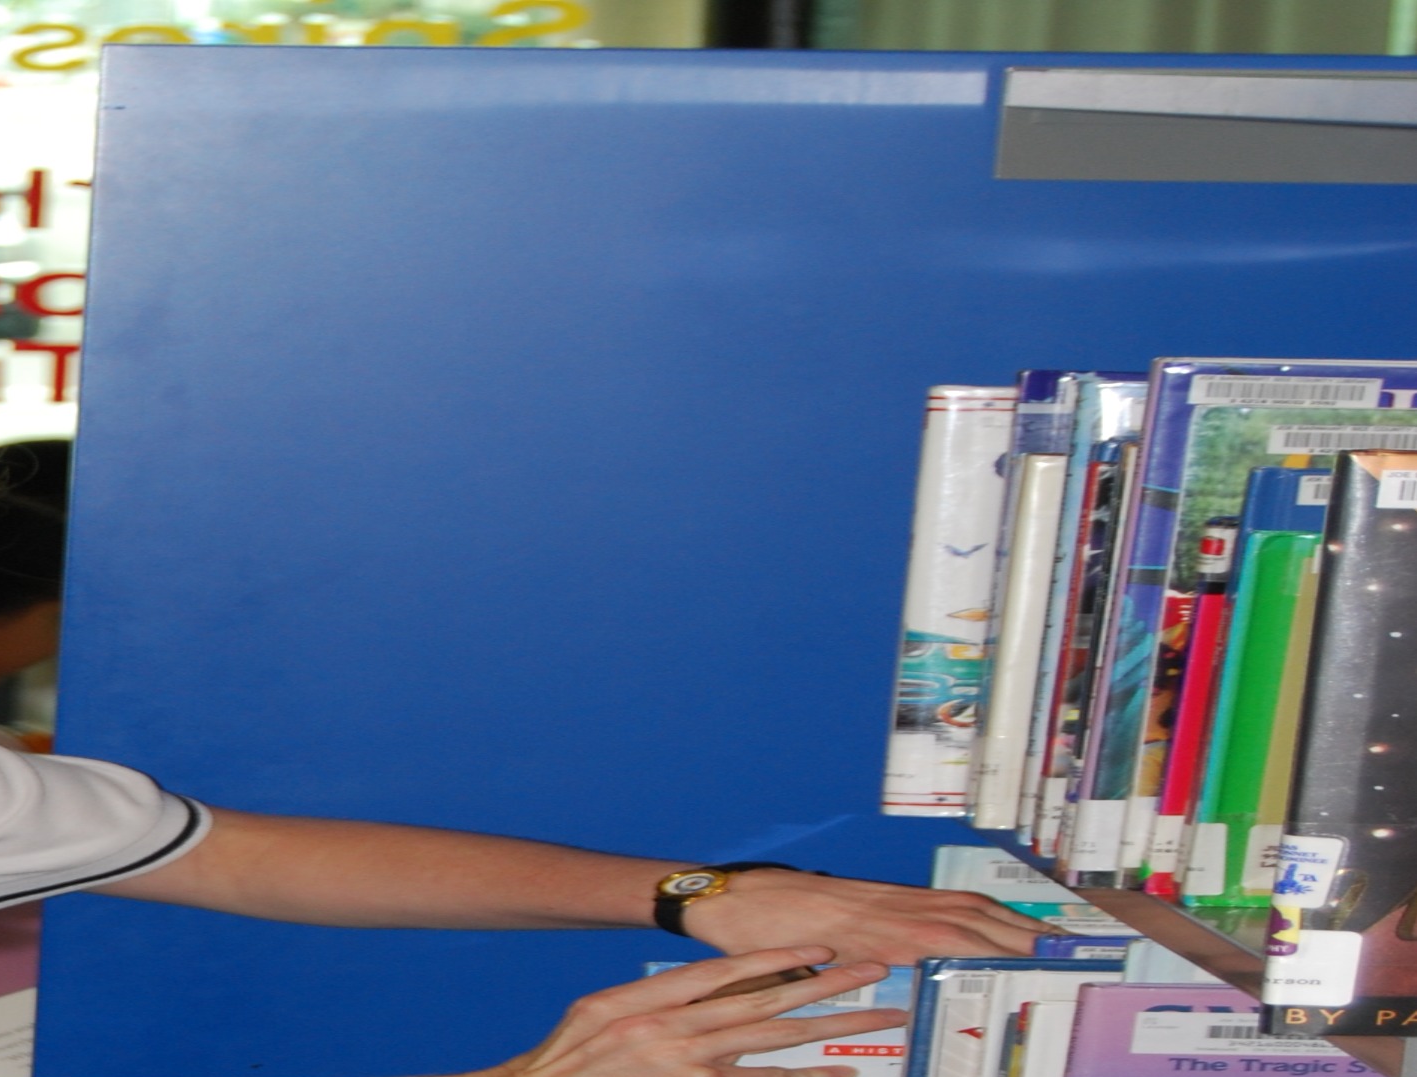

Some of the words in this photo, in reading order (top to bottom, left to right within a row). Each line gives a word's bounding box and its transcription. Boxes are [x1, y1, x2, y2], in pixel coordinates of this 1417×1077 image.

[1285, 1008, 1346, 1026] BY
[1169, 1057, 1228, 1072] The
[1240, 1058, 1337, 1076] Tragic
[1347, 1060, 1380, 1074] S
